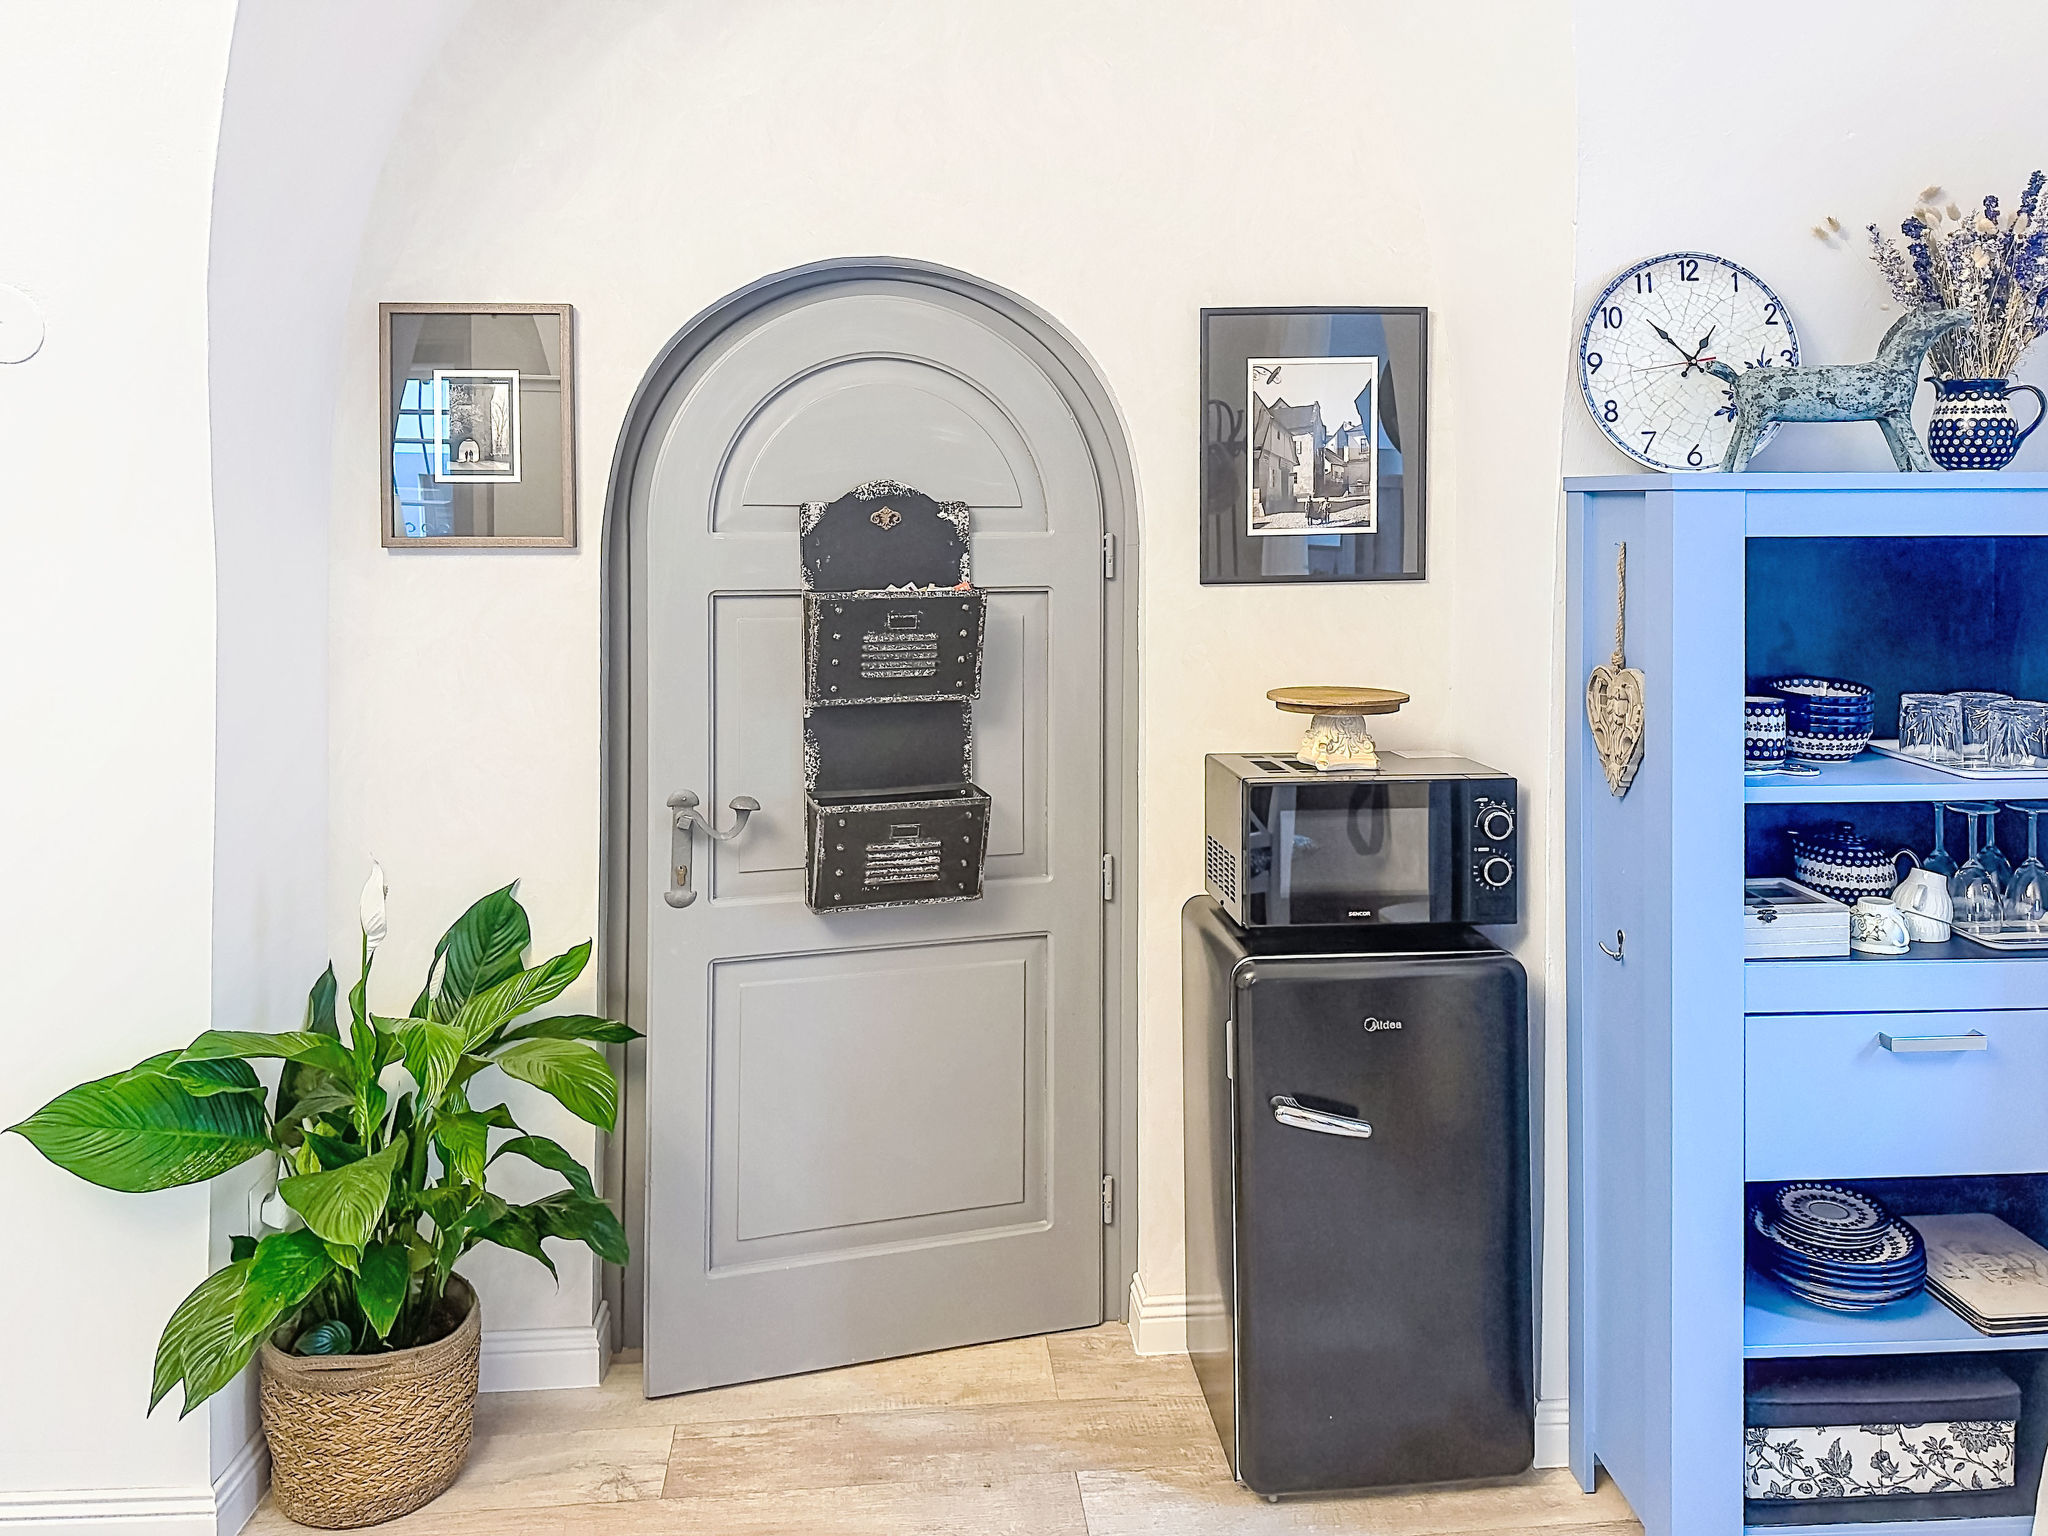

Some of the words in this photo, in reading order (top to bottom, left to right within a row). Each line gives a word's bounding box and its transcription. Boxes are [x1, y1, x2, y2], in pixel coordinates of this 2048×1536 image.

[1678, 259, 1700, 281] 12
[1635, 272, 1652, 293] 11
[1731, 272, 1738, 292] 1
[1601, 306, 1623, 328] 10
[1764, 303, 1778, 325] 2
[1587, 352, 1603, 375] 9
[1604, 400, 1618, 422] 8
[1641, 431, 1656, 454] 7
[1687, 444, 1703, 466] 6
